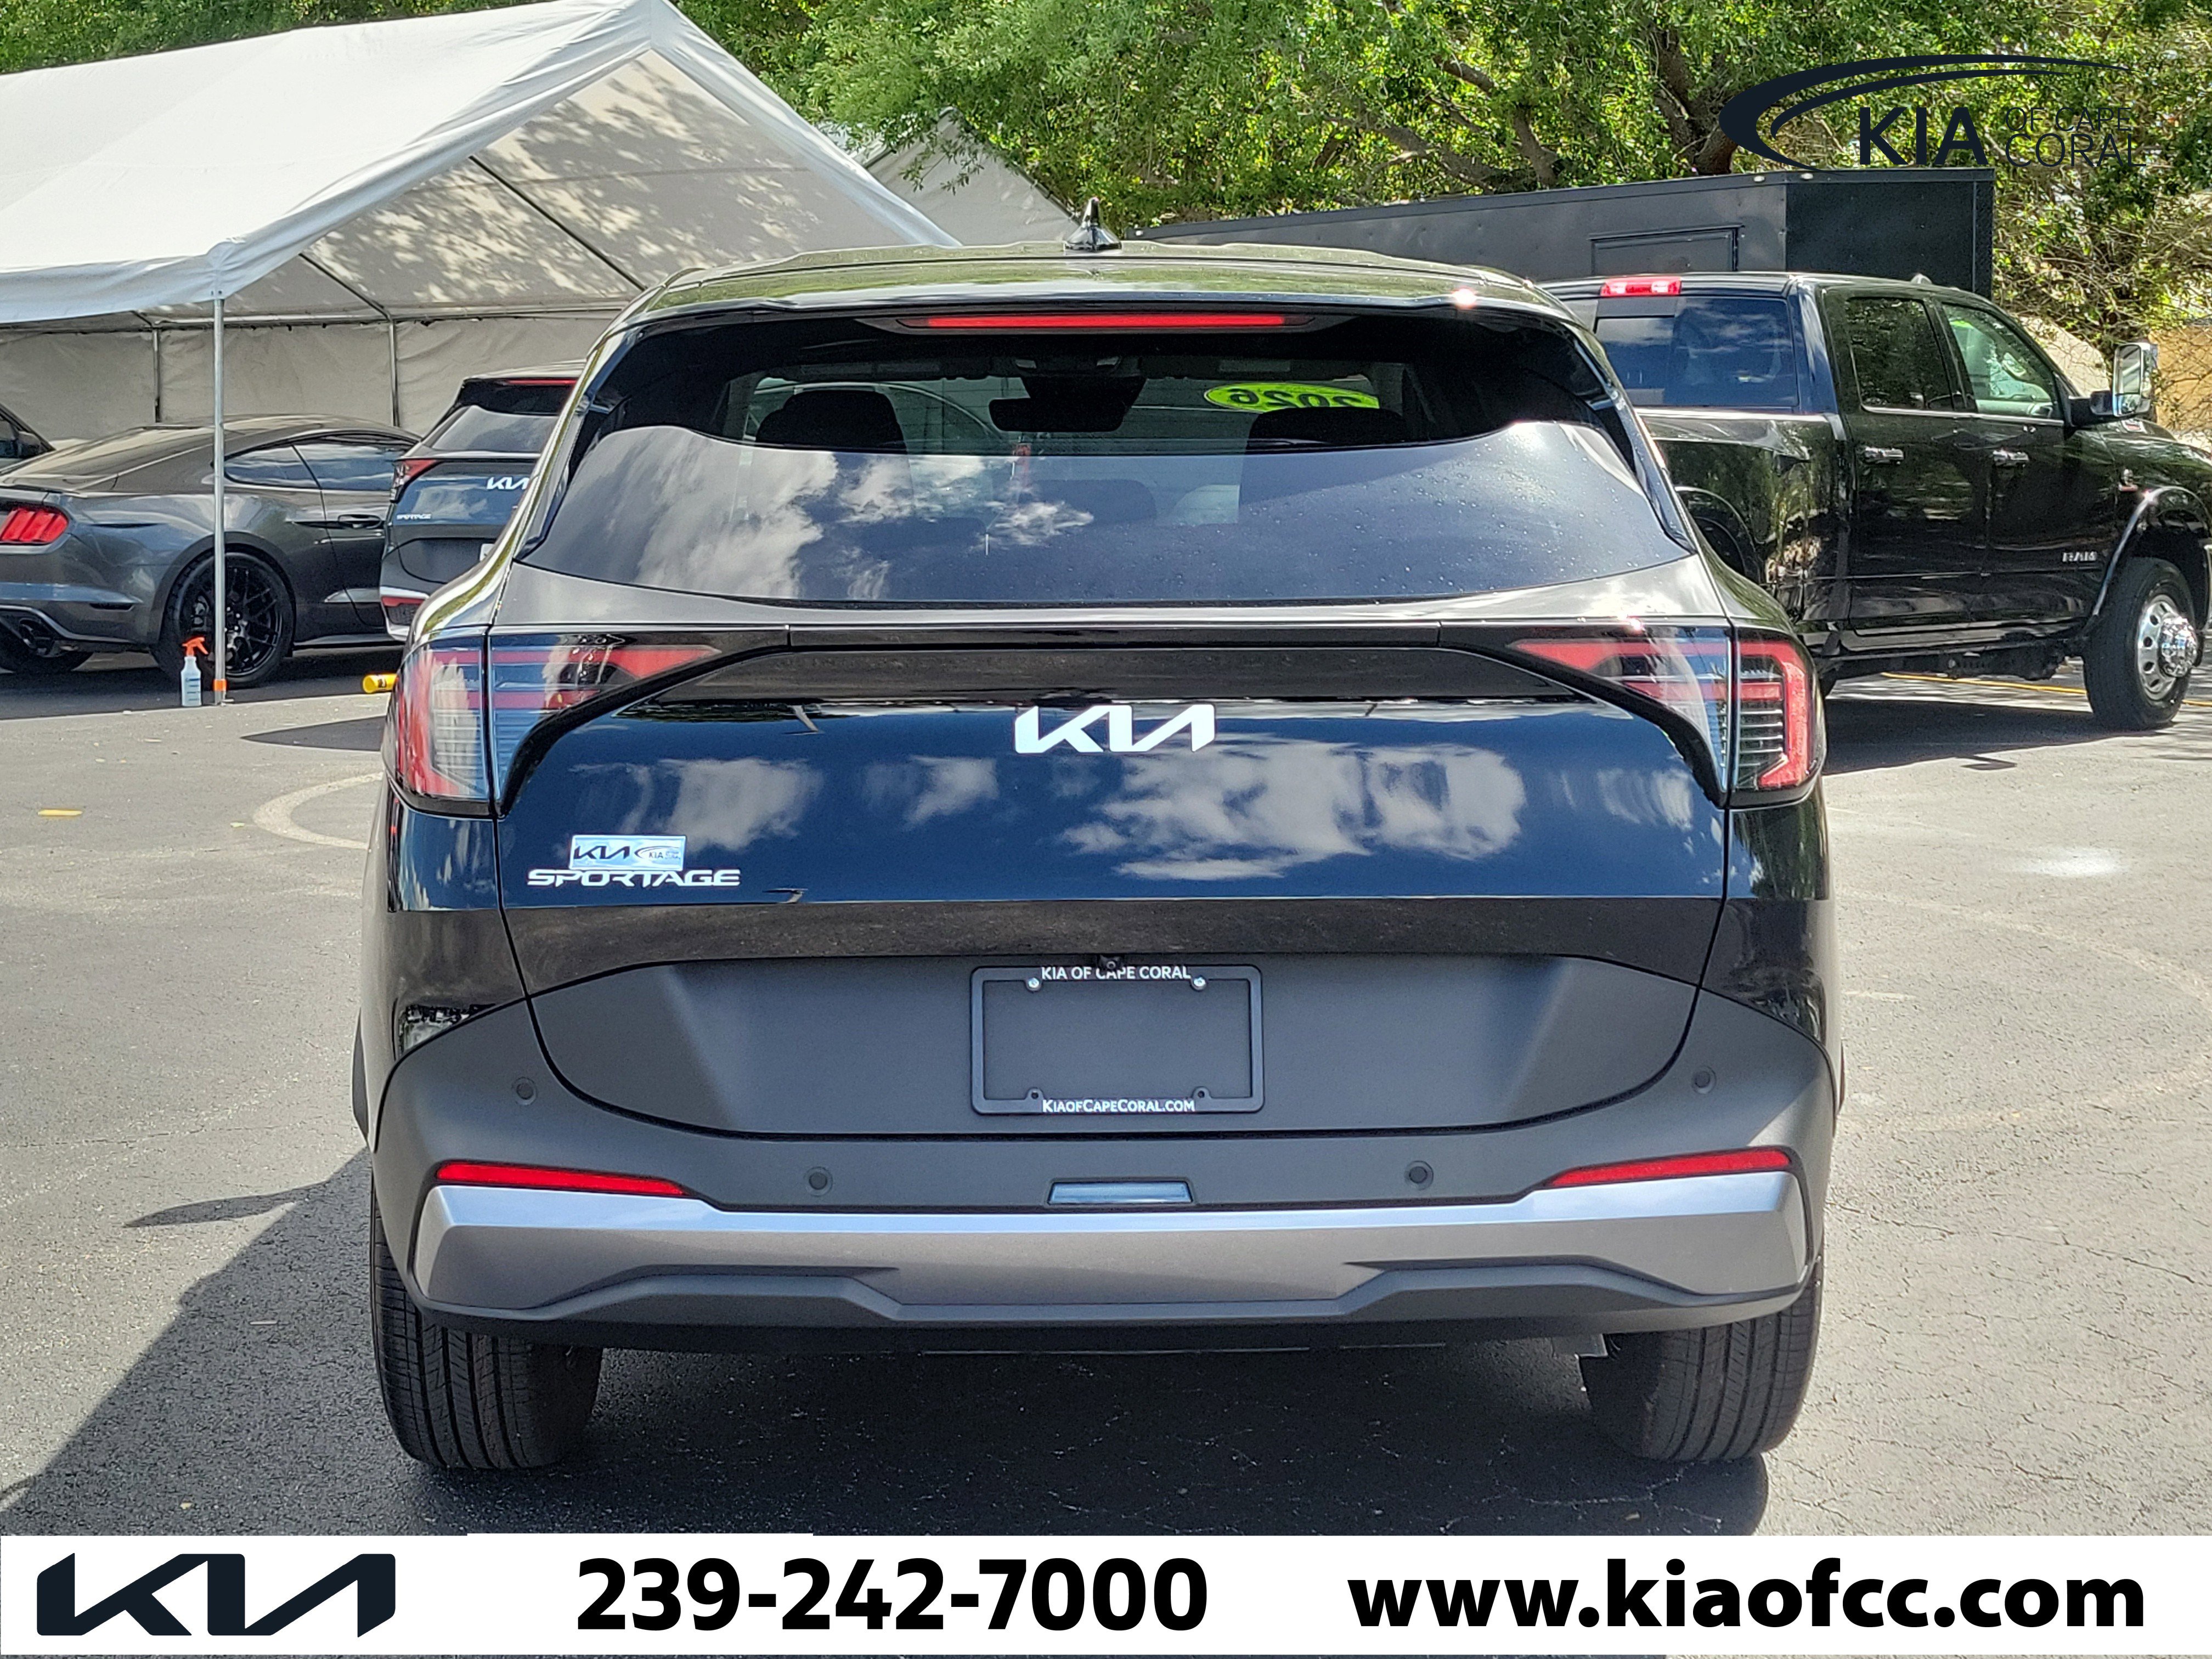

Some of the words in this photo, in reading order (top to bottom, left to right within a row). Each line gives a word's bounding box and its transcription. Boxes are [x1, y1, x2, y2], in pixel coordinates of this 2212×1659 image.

[1015, 704, 1215, 753] KIA
[573, 845, 630, 860] KIA
[527, 869, 741, 888] SPORTAGE
[1041, 966, 1068, 980] KIA
[1071, 966, 1092, 980] OF
[1139, 966, 1192, 979] CORAL
